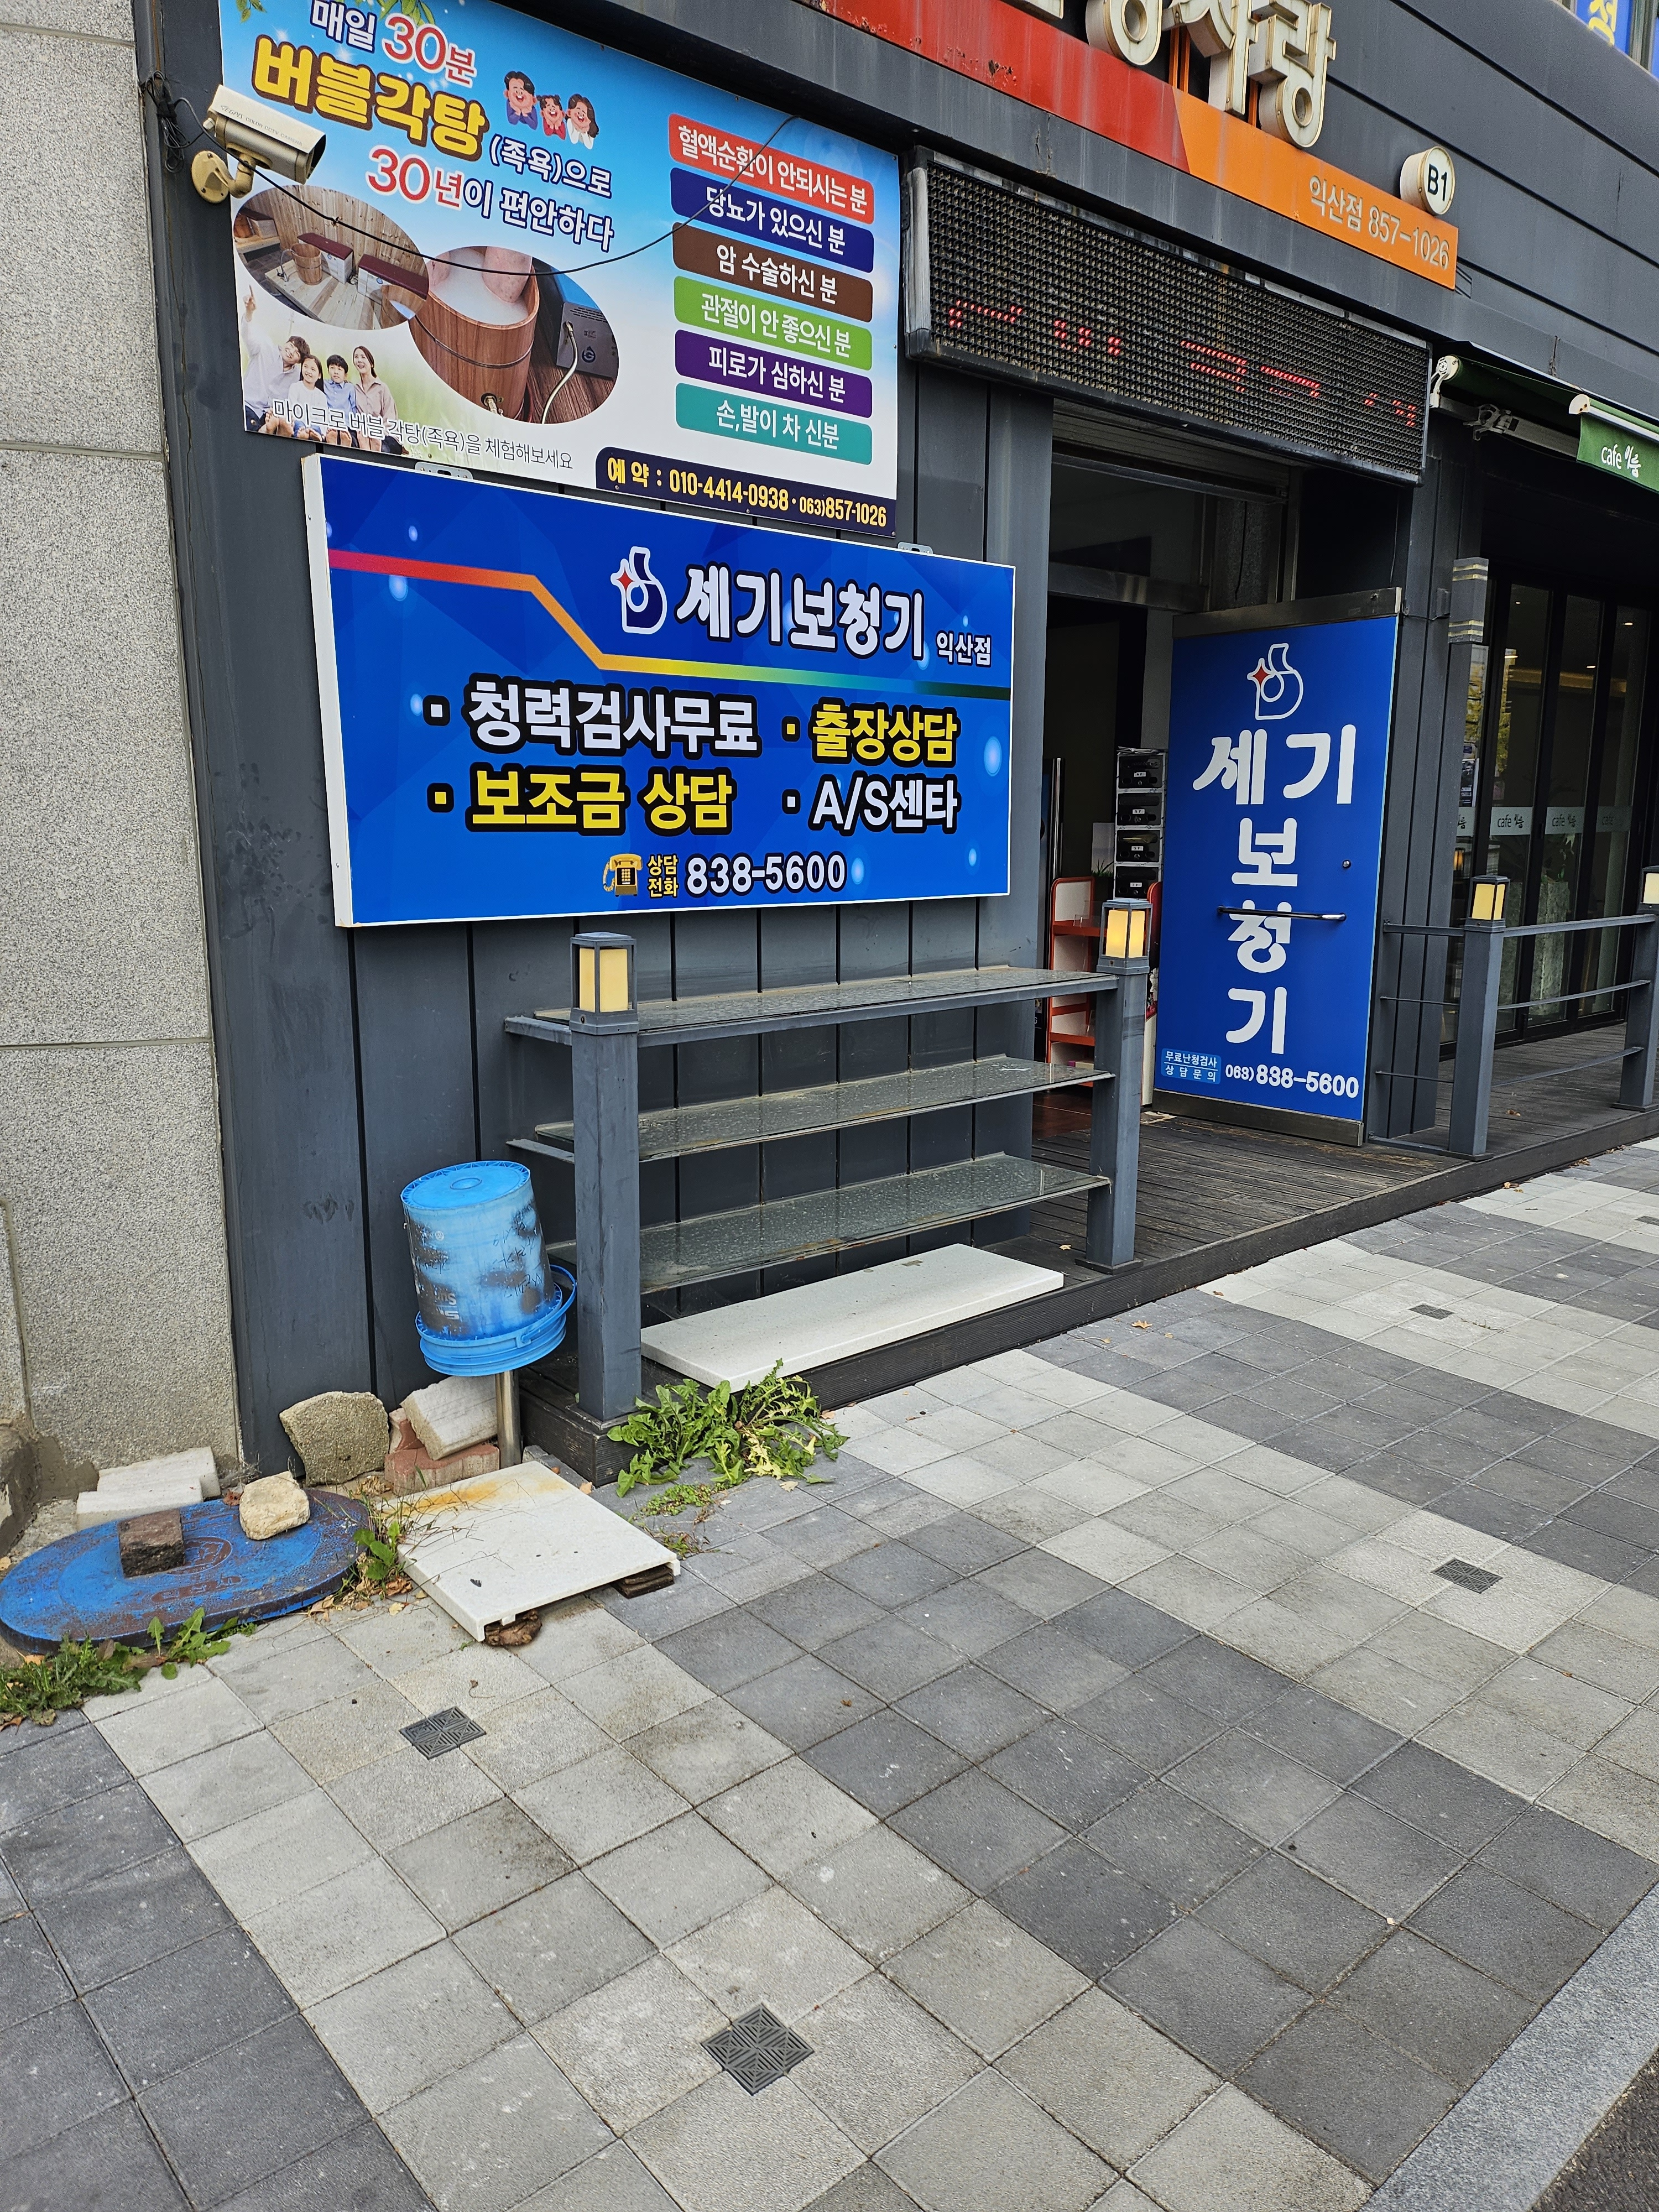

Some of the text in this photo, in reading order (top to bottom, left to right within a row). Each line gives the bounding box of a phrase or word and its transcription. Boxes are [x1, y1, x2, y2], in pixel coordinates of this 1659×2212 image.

[311, 0, 477, 87] 매일 30분
[253, 35, 612, 198] 버블각탕 (족욕)으로
[366, 145, 614, 252] 30년이 편안하다
[679, 126, 867, 215] 혈액순환이 안되시는 분
[1428, 164, 1449, 196] B1
[706, 186, 846, 255] 당뇨가 있으신 분
[1309, 175, 1449, 269] 익산점 857-1026
[717, 245, 838, 305] 암 수술하신 분
[701, 293, 851, 358] 관절이 안 좋으신 분
[708, 346, 846, 404] 피로가 심하신 분
[273, 398, 573, 471] 마이크로 버블 각탕(족욕)을 체험해보세요
[716, 401, 839, 450] 손,발이 차 신분
[1601, 444, 1622, 469] cafe
[670, 469, 789, 511] 010-4414-0938
[800, 496, 886, 528] 063)857-1026
[676, 562, 992, 666] 세기보청기 익산점
[469, 681, 957, 763] 청력검사무료 출장상담
[471, 770, 957, 832] 보조금 상담 A/S센타
[1498, 815, 1511, 828] cafe
[1552, 815, 1564, 827] cafe
[647, 855, 678, 876] 상담
[647, 877, 679, 899] 전화
[686, 854, 846, 895] 838-5600
[1165, 1051, 1218, 1068] 무료난청검사
